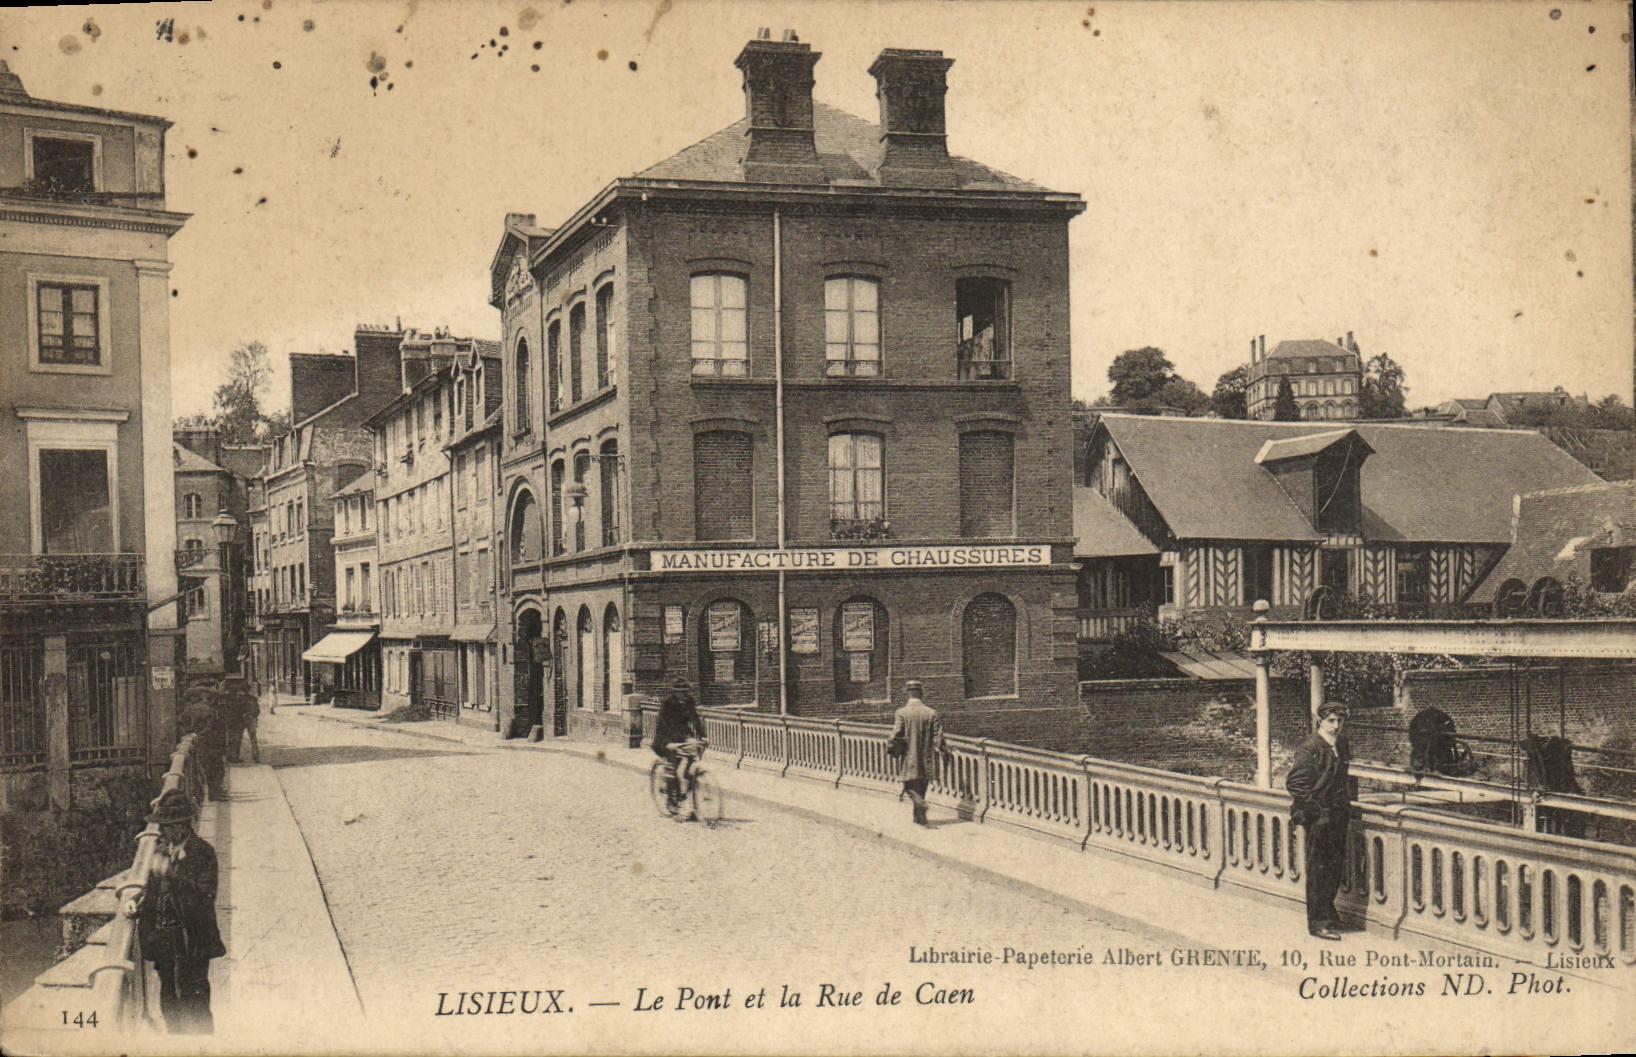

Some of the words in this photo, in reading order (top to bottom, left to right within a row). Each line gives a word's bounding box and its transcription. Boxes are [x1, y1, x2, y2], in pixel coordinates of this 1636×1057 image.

[661, 552, 836, 569] MANUFACTURE
[847, 551, 880, 567] DE
[890, 547, 1043, 565] CHAUSSURES
